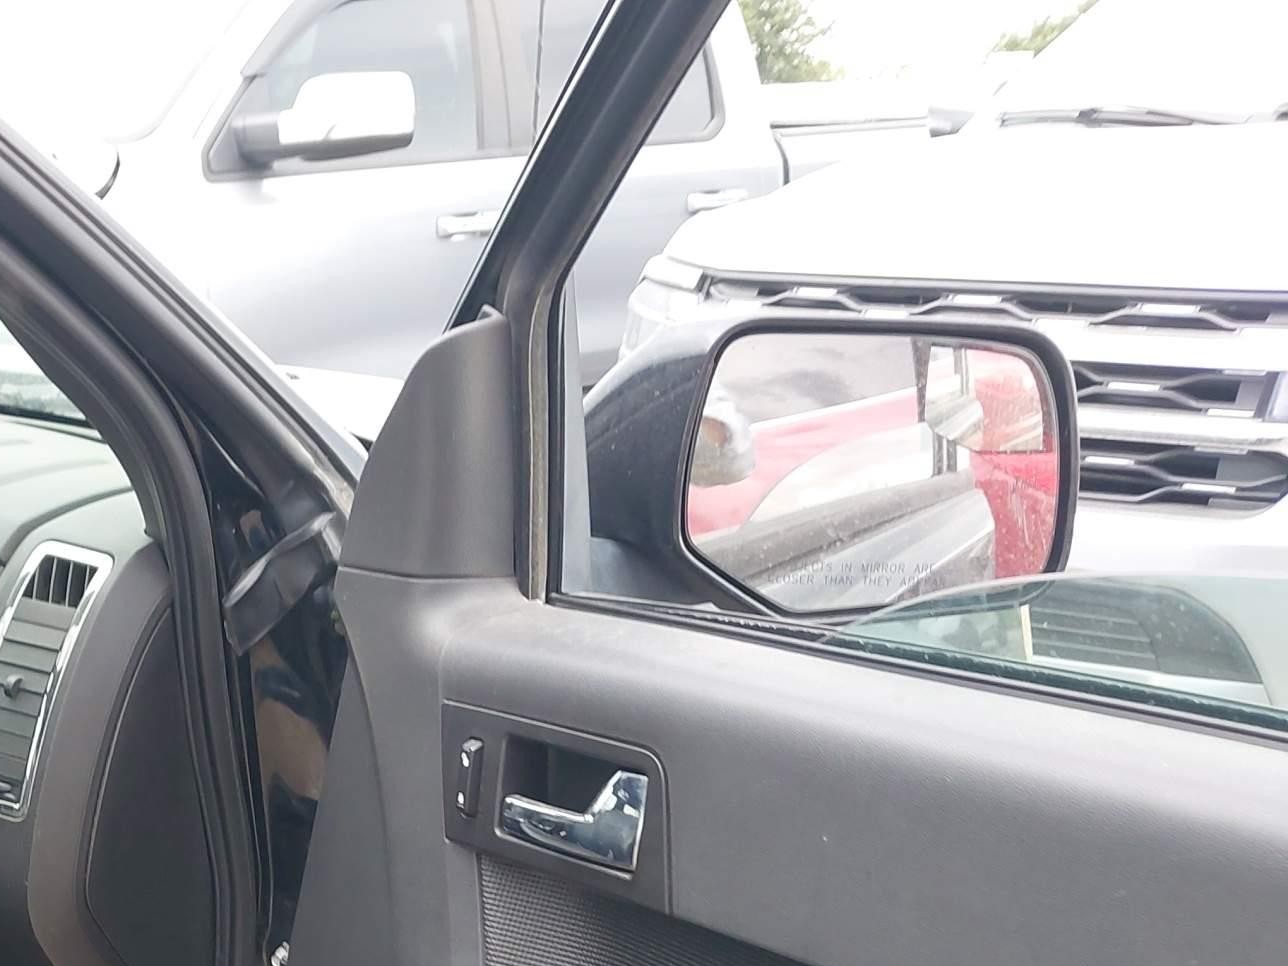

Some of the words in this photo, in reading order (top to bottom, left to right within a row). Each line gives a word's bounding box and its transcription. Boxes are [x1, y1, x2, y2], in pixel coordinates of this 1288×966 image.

[779, 560, 833, 573] JECTS
[841, 560, 853, 573] IN
[861, 560, 906, 574] MIRROR
[823, 574, 854, 586] THAN
[863, 574, 891, 587] THEY
